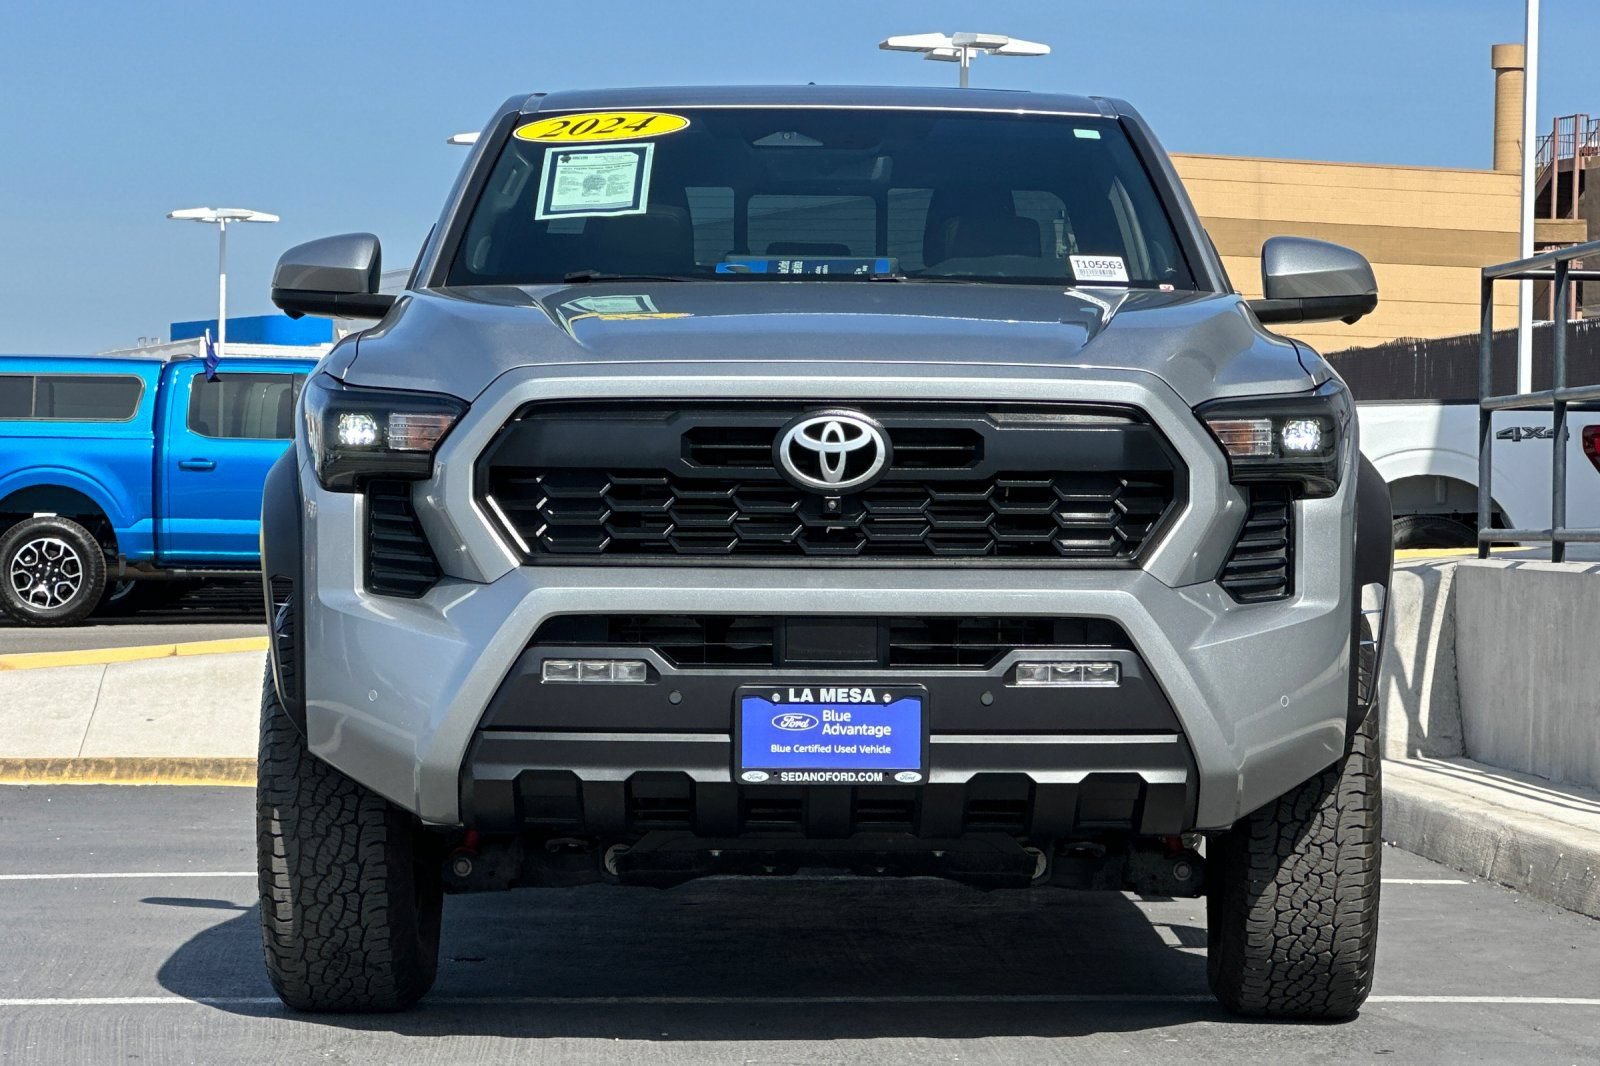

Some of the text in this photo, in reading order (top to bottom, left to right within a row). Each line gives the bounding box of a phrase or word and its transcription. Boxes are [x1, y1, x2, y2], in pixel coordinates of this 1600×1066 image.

[537, 115, 658, 138] 2024
[1075, 260, 1123, 270] T105563
[788, 688, 876, 703] LA MESA
[780, 715, 810, 728] Ford
[822, 710, 852, 722] Blue
[822, 723, 892, 738] Advantage
[770, 744, 892, 754] Blue Certified Used Vehicle
[780, 772, 883, 782] SEDANOFORD.COM
